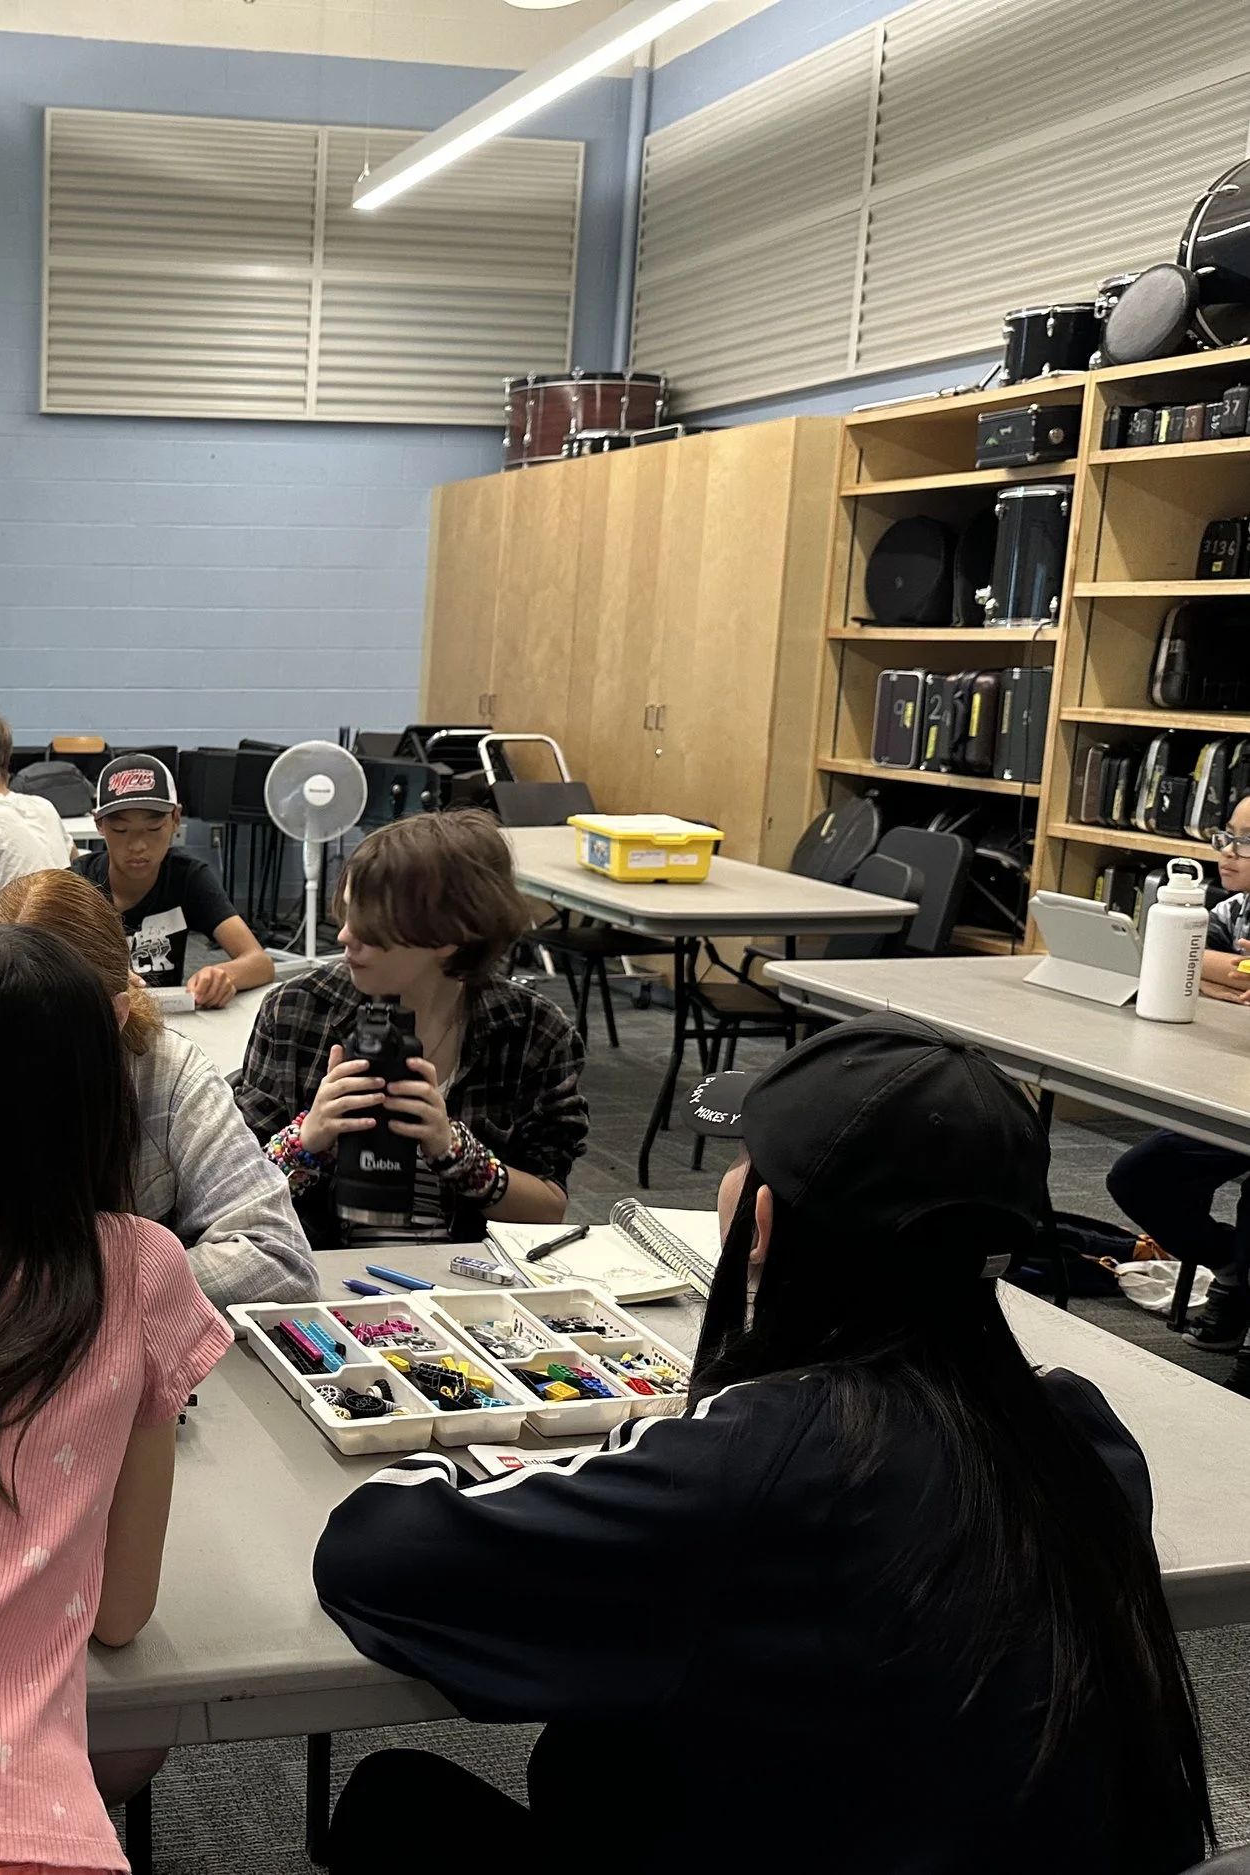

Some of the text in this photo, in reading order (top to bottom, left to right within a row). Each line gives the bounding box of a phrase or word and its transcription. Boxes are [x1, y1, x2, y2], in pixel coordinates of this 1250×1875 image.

[1222, 399, 1240, 417] 37
[1160, 781, 1173, 794] 53
[1183, 934, 1203, 997] lululemon
[694, 1105, 729, 1123] MAKES
